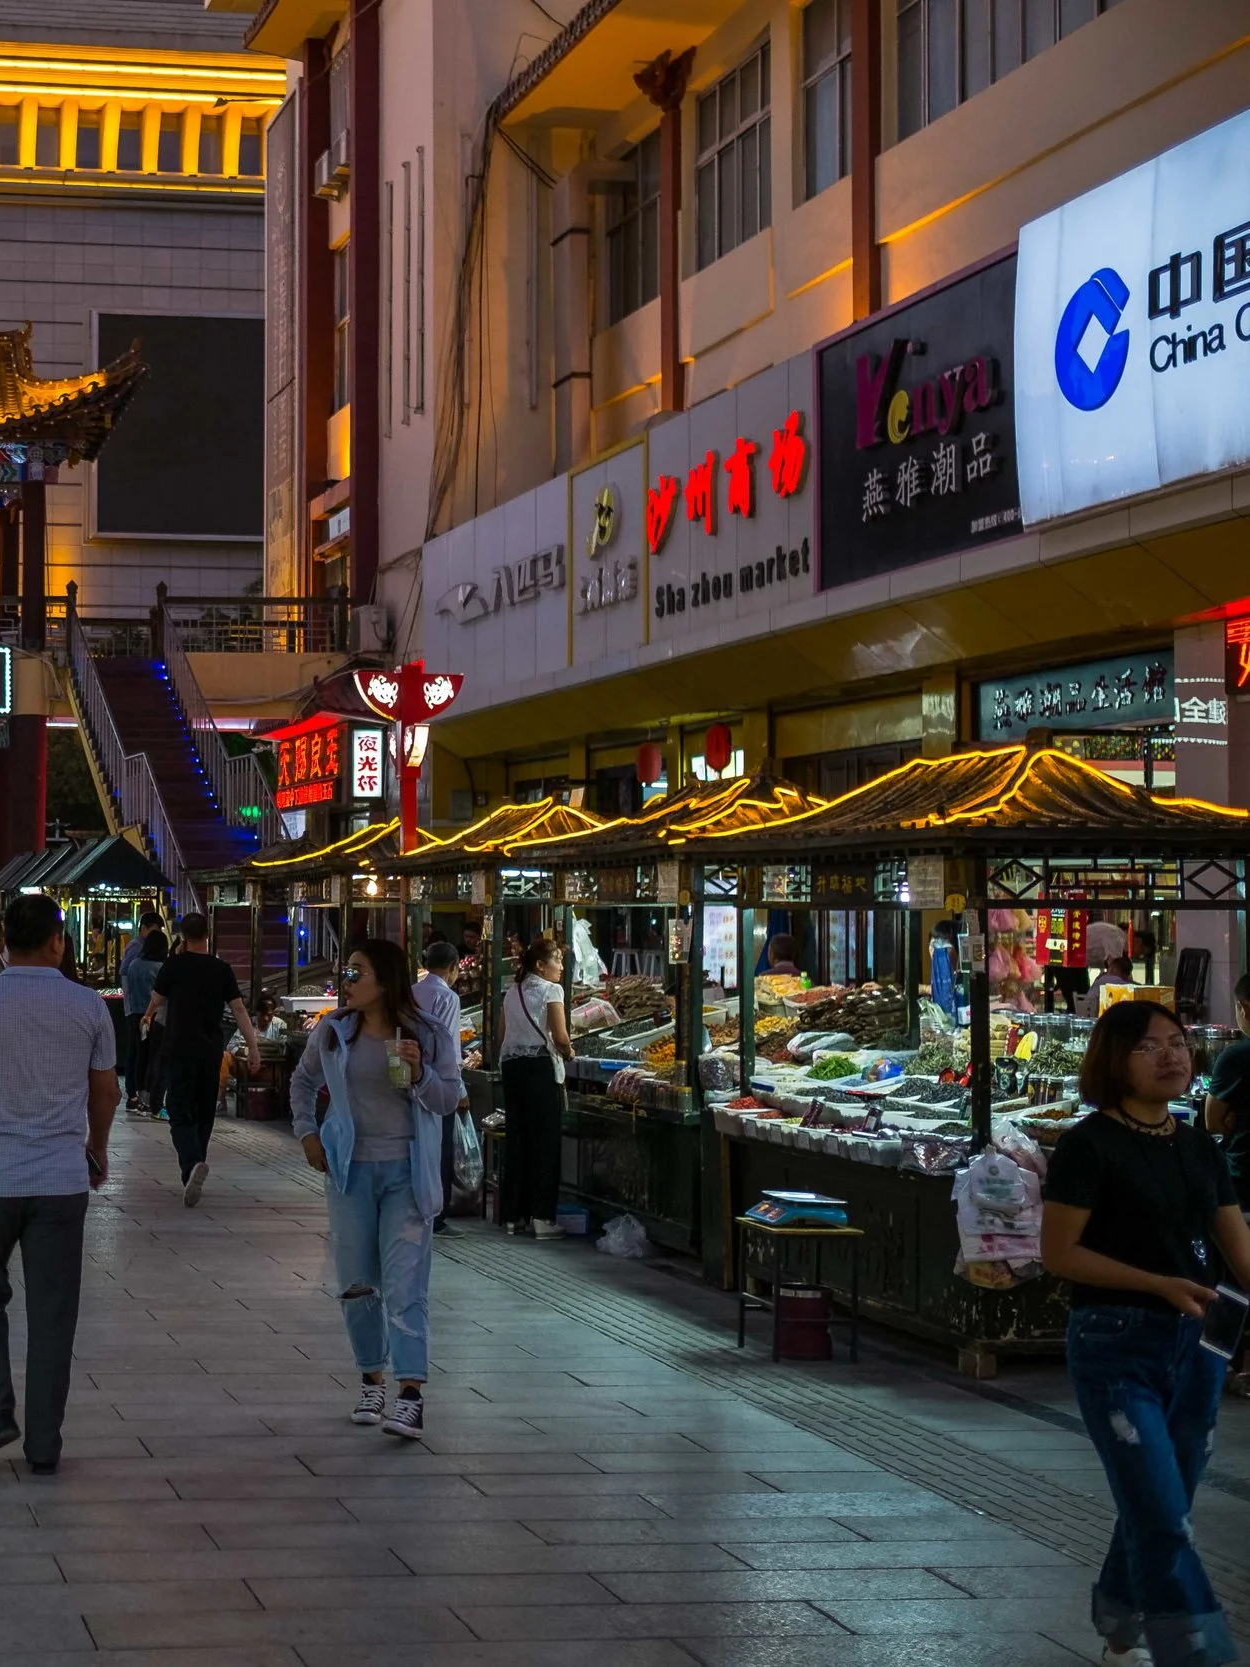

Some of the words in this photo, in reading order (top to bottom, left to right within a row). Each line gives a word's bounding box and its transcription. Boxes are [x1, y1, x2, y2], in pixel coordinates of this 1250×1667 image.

[1148, 219, 1250, 321] 中国
[1149, 323, 1226, 373] China
[861, 432, 994, 523] 燕雅潮品
[654, 583, 686, 619] Sha
[691, 571, 734, 608] zhou
[739, 536, 811, 593] market
[357, 735, 378, 792] 夜光杯
